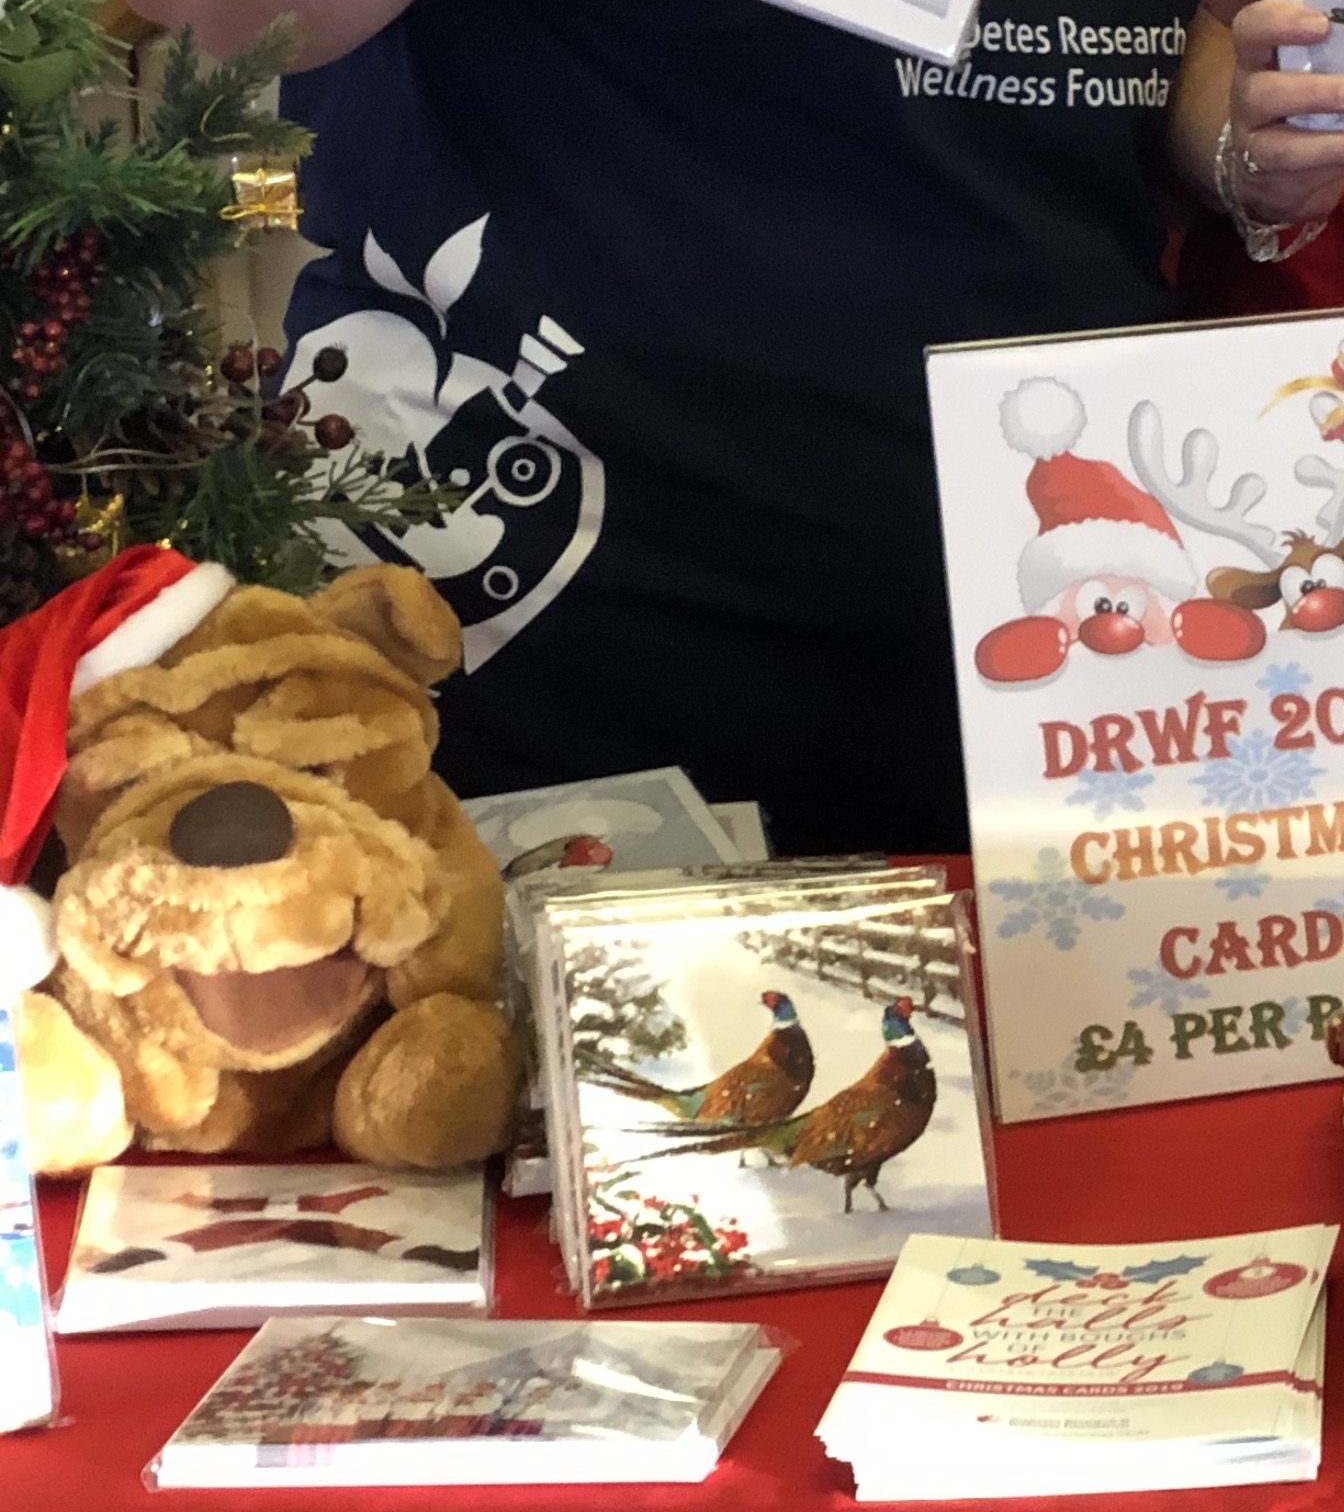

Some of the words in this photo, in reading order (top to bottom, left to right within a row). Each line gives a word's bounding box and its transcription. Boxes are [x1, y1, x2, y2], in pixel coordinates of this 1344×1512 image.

[1058, 15, 1187, 55] Research
[894, 57, 1056, 106] Wellness
[1039, 690, 1248, 779] DRWF
[1075, 1020, 1153, 1072] £4
[1170, 1000, 1292, 1059] PER
[973, 1329, 1051, 1341] WITH
[1060, 1330, 1187, 1342] BOUGHS
[945, 1380, 1058, 1395] CHRISTMAS
[1062, 1384, 1129, 1395] CARDS
